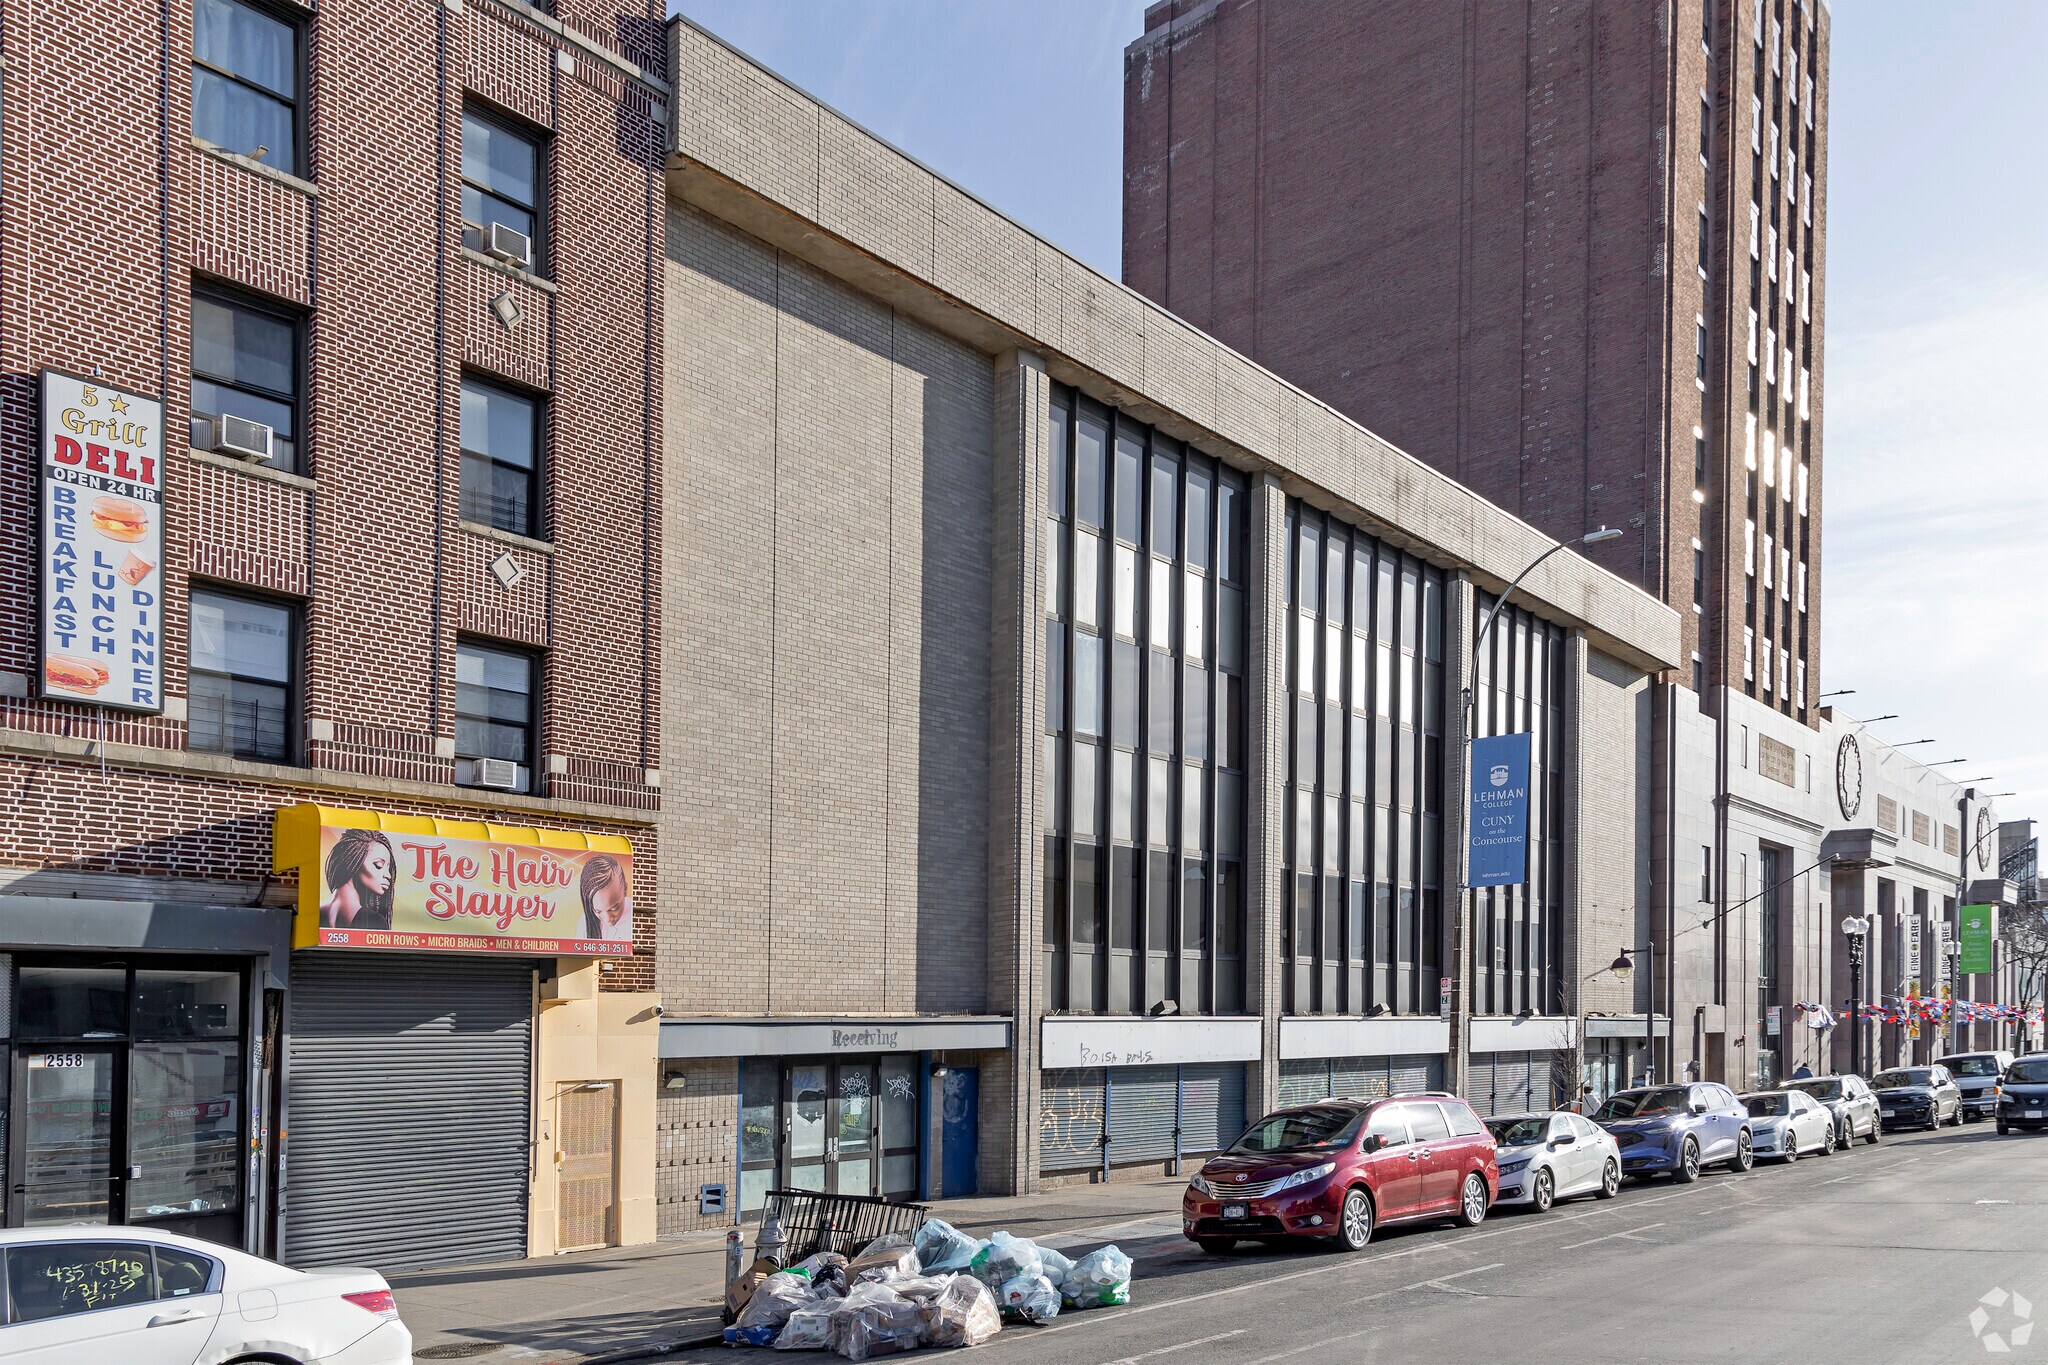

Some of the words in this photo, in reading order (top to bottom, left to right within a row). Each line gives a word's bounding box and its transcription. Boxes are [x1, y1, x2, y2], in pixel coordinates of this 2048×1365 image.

[81, 385, 98, 407] 5
[61, 409, 147, 448] Grill
[55, 435, 155, 485] DELI
[54, 468, 100, 490] OPEN
[107, 479, 127, 496] 24
[133, 485, 156, 503] HR
[53, 486, 77, 648] BREAKFAST
[92, 550, 115, 655] LUNCH
[131, 589, 154, 705] DINNER
[1474, 788, 1524, 803] LEHMAN
[1483, 800, 1512, 809] COLLEGE
[1482, 815, 1514, 827] CUNY
[1472, 834, 1522, 846] Concourse
[401, 842, 479, 882] The
[491, 848, 574, 891] Hair
[425, 882, 556, 932] Slayer
[327, 932, 349, 943] 2558
[366, 933, 391, 945] CORN
[393, 934, 419, 946] ROWS
[428, 936, 455, 947] MICRO
[457, 937, 488, 949] BRAIDS
[496, 938, 512, 949] MEN
[514, 940, 520, 949] &
[522, 939, 559, 951] CHILDREN
[1911, 920, 1919, 943] FARE
[584, 943, 628, 953] 646-361-2511
[1911, 952, 1919, 971] FINE
[831, 1029, 898, 1049] Receiving
[47, 1053, 83, 1067] 2558
